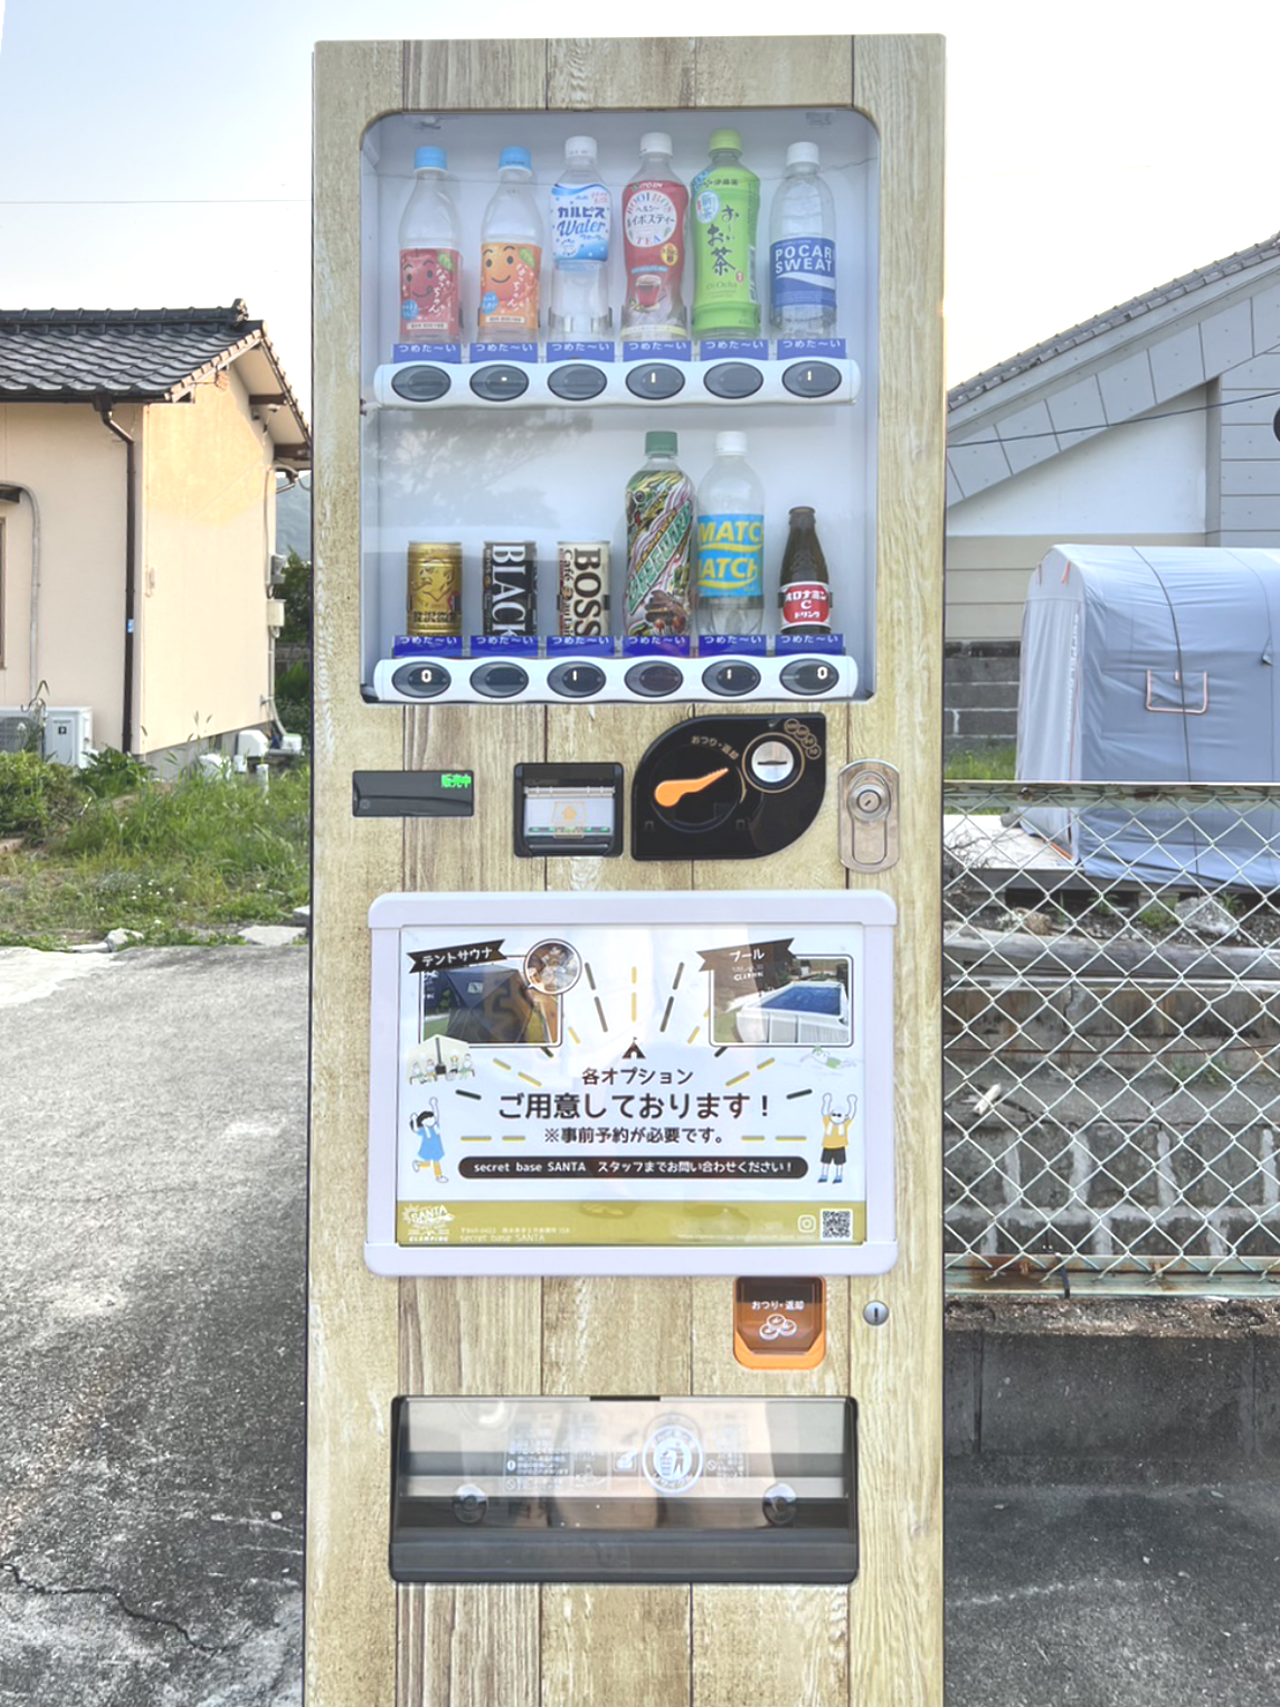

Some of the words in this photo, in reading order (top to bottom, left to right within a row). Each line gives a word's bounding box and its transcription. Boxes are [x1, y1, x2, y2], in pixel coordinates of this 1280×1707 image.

[557, 206, 605, 218] カルピス
[557, 219, 606, 236] Water
[775, 257, 832, 274] SWEAT
[492, 545, 526, 637] BLACK
[573, 547, 602, 637] BOSS
[801, 600, 812, 610] C
[422, 946, 492, 967] テントサウナ
[582, 1067, 693, 1086] 各オプション
[545, 1126, 723, 1144] ※事前予約が必要です。
[474, 1161, 510, 1173] secret
[515, 1161, 543, 1173] base
[547, 1161, 586, 1172] SANTA
